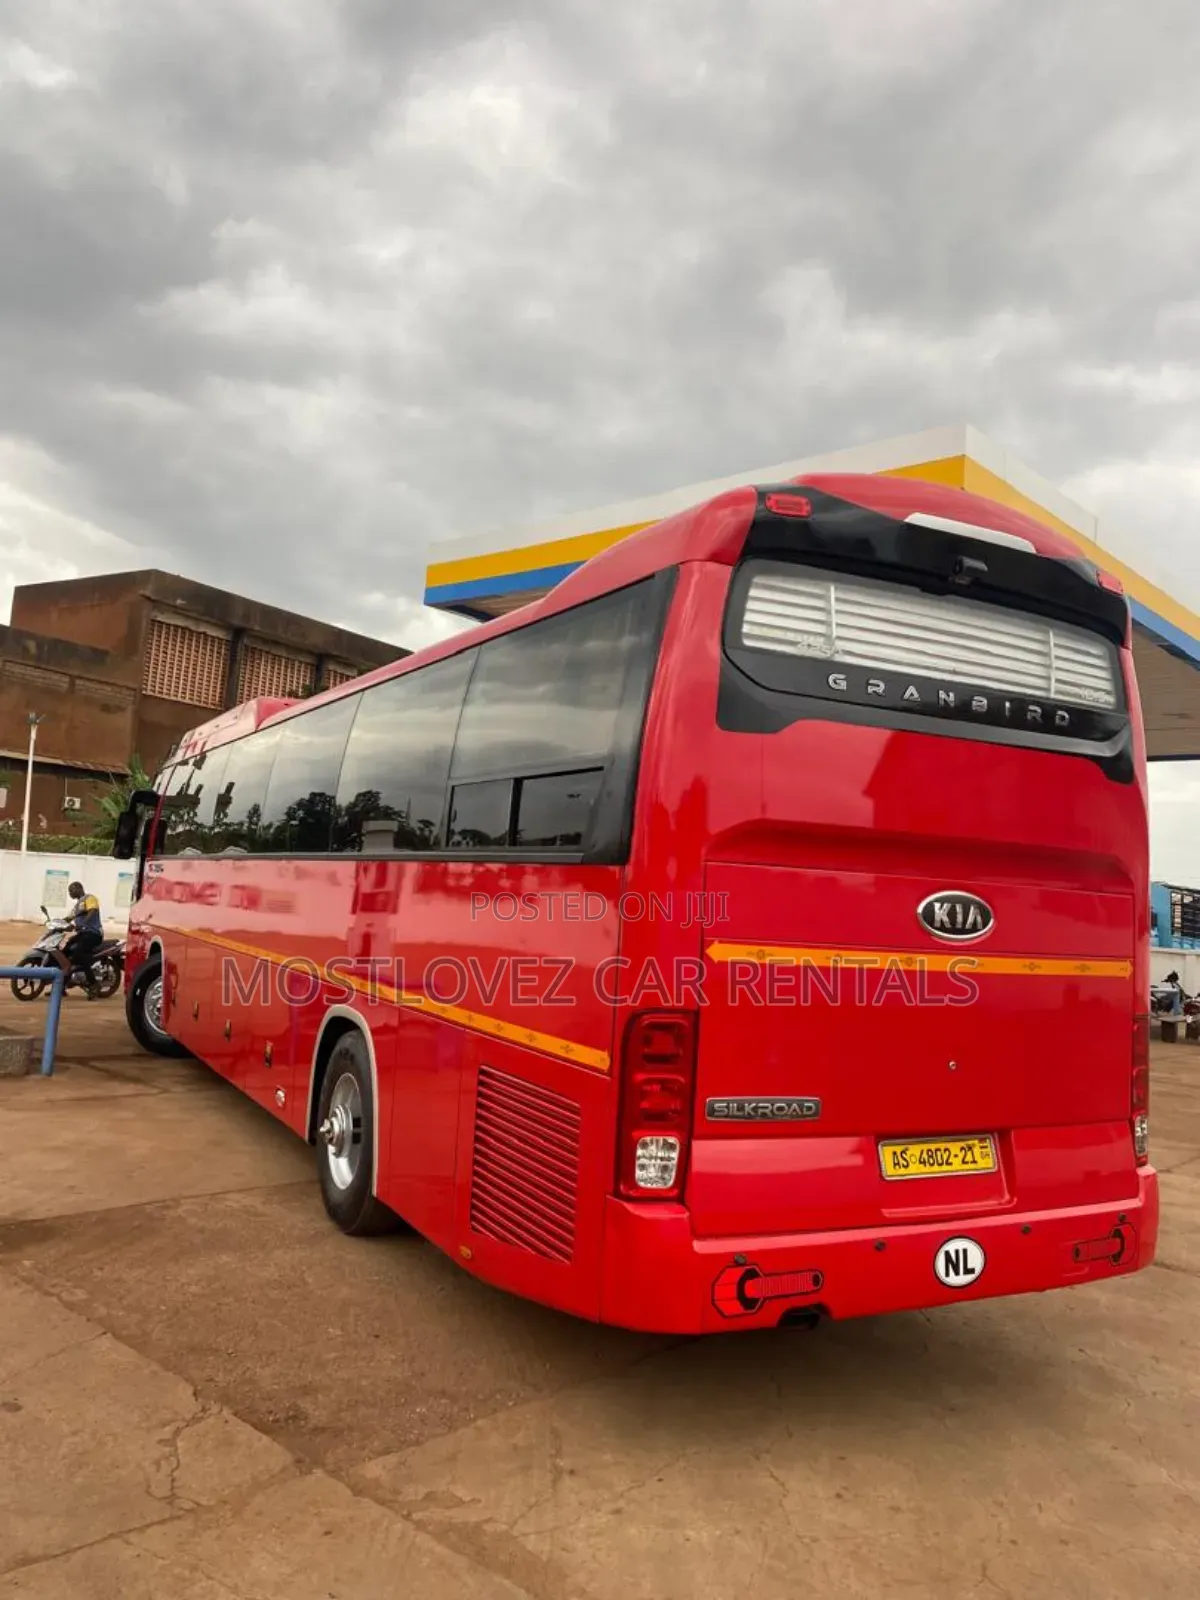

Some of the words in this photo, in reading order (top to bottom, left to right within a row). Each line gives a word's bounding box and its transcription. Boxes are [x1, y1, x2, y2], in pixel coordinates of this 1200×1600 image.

[827, 672, 1072, 727] GRANBIRD
[932, 901, 983, 931] KIA
[713, 1102, 816, 1117] SILKROAD
[892, 1148, 910, 1170] AS
[918, 1145, 978, 1168] 4802-21
[944, 1248, 975, 1278] NL
